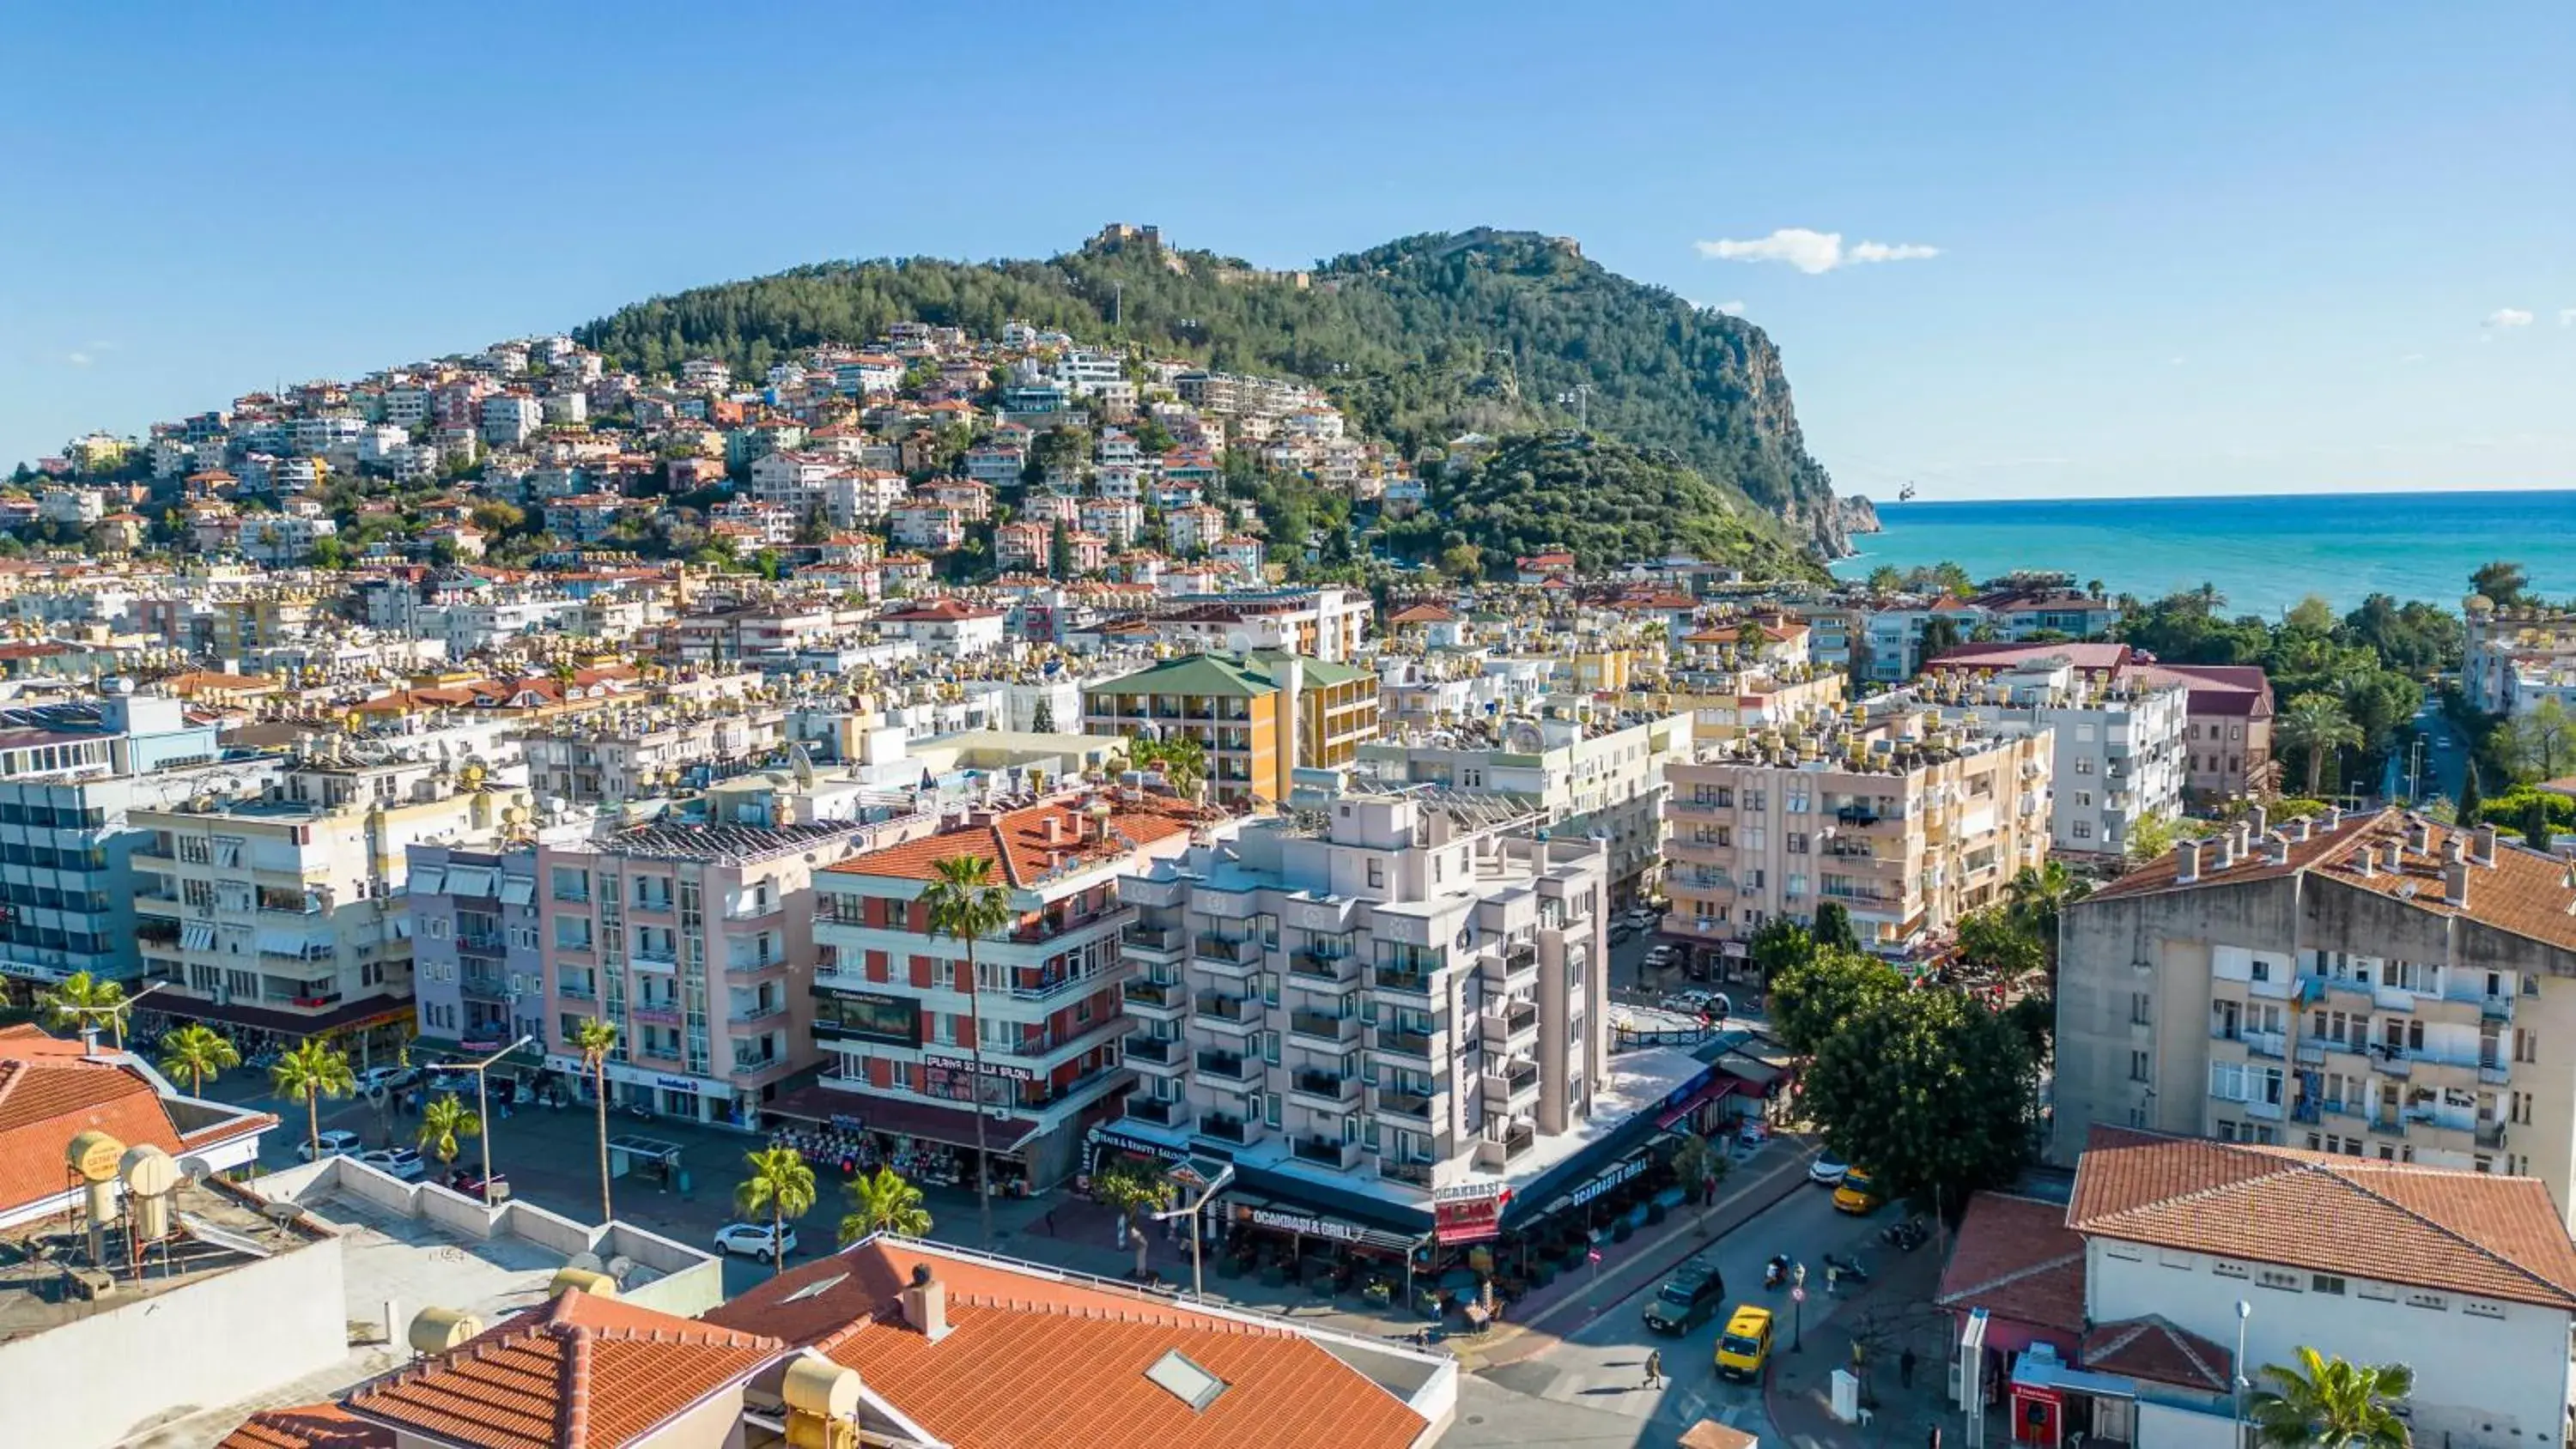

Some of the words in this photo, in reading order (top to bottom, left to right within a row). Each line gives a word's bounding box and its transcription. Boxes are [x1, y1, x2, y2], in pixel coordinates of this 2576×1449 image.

[1624, 1158, 1647, 1179] GRILL
[1253, 1210, 1311, 1234] OCAKBAŞI
[1311, 1220, 1320, 1234] &
[1321, 1222, 1352, 1239] GRILL
